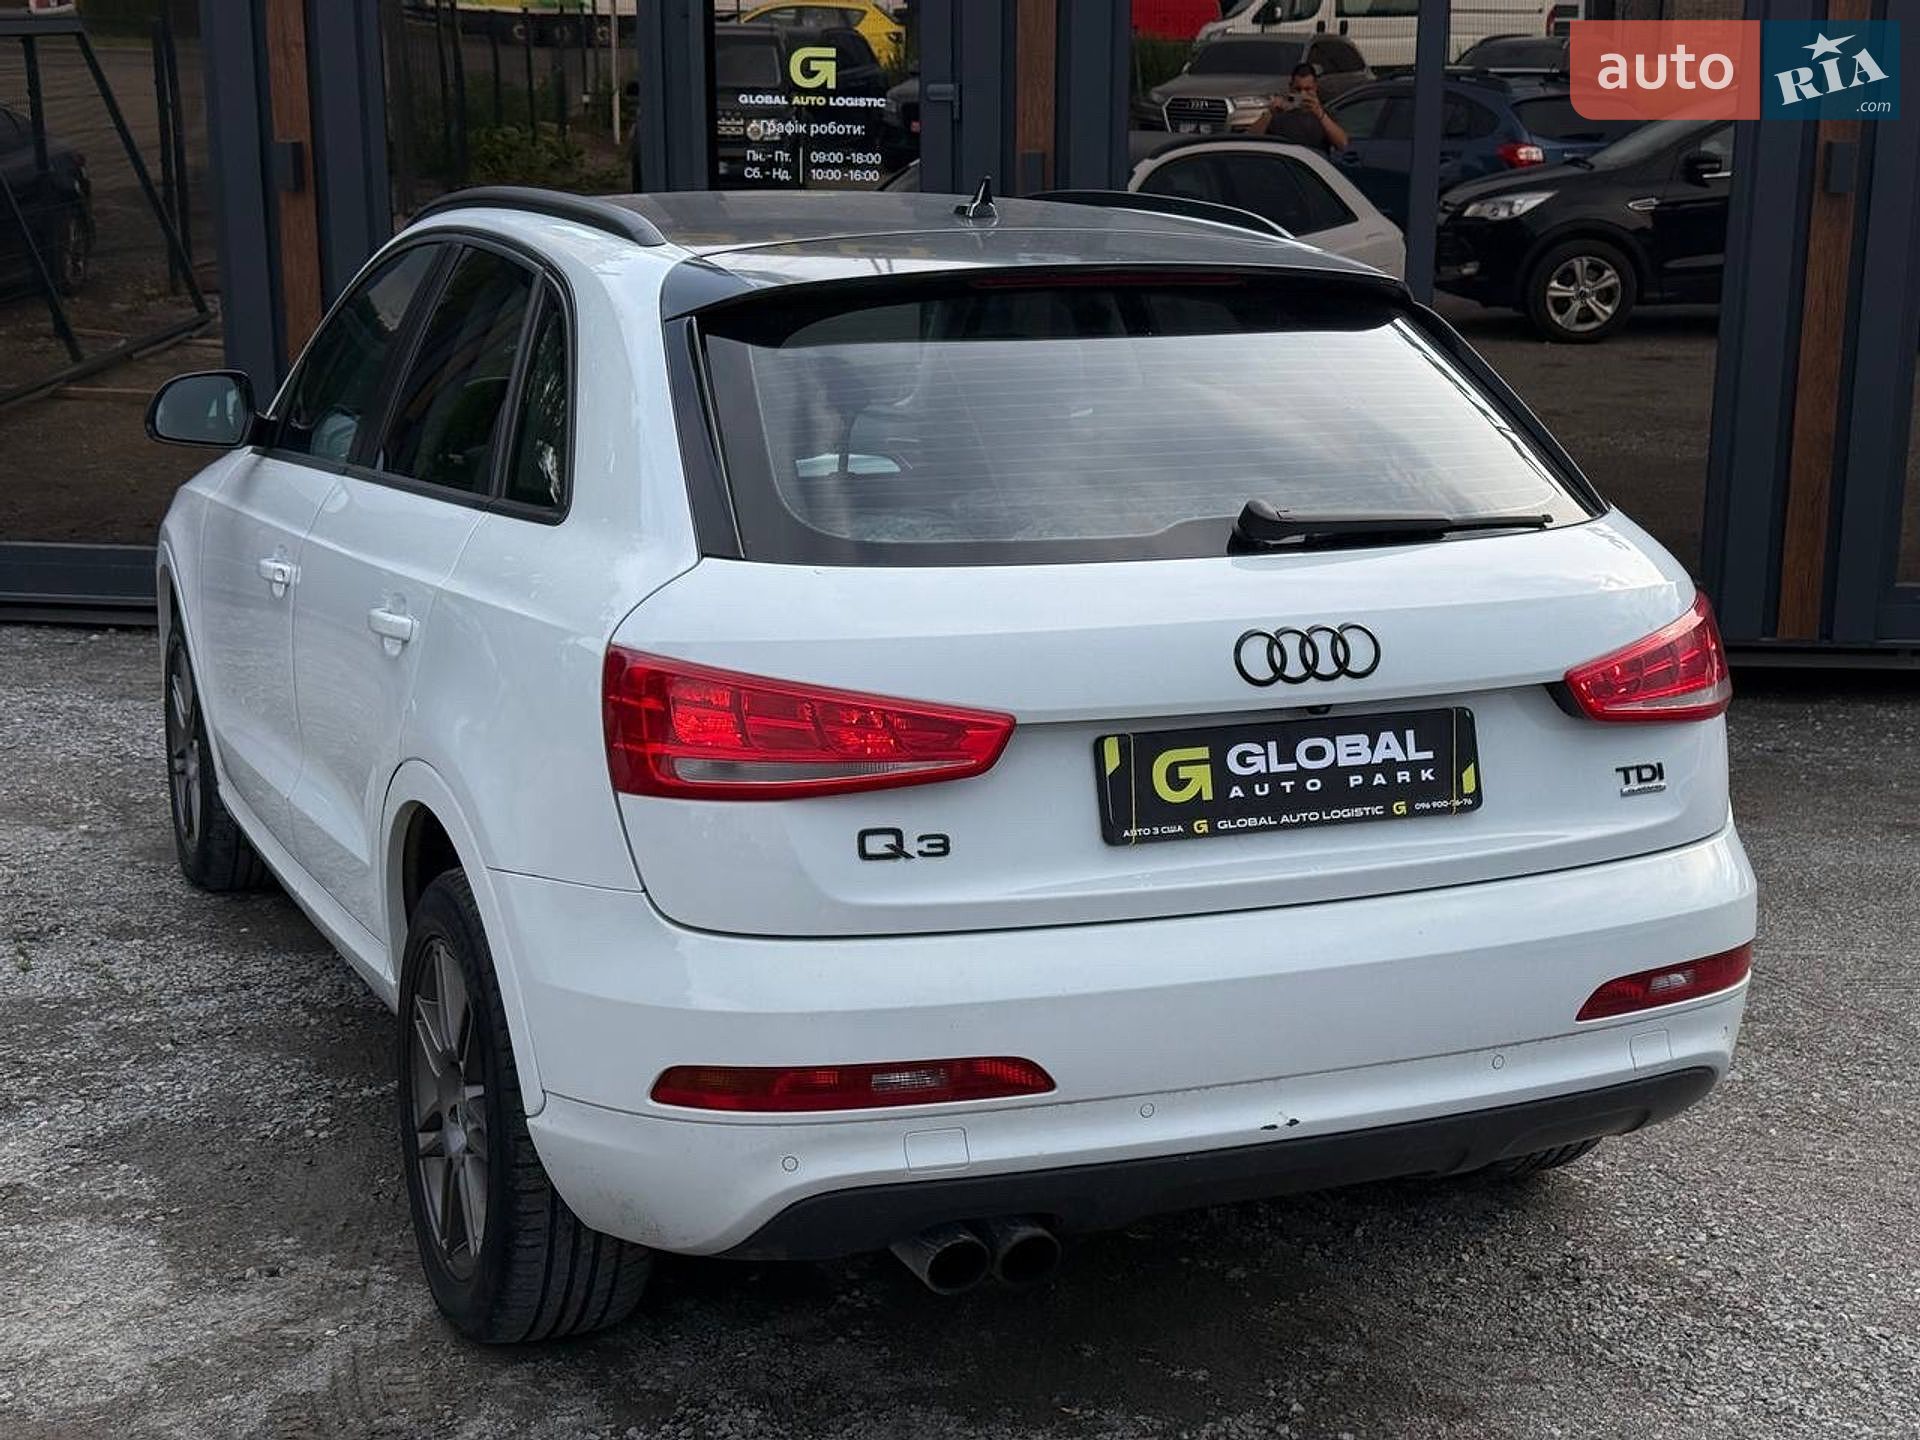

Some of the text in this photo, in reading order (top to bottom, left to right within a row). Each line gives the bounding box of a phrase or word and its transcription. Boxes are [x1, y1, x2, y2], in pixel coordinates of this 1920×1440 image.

[738, 94, 886, 108] GLOBAL AUTO LOGISTIC
[760, 120, 866, 137] Графік роботи:
[746, 149, 766, 162] Пн.
[774, 150, 792, 163] Пт.
[810, 151, 844, 164] 09:00
[744, 166, 763, 179] Сб.
[772, 168, 792, 181] Нд.
[810, 168, 842, 181] 10:00
[1226, 729, 1434, 776] GLOBAL
[1615, 762, 1665, 785] TDI
[1229, 768, 1436, 799] AUTO PARK
[1217, 805, 1385, 830] GLOBAL AUTO LOGISTIC
[857, 827, 951, 861] Q3
